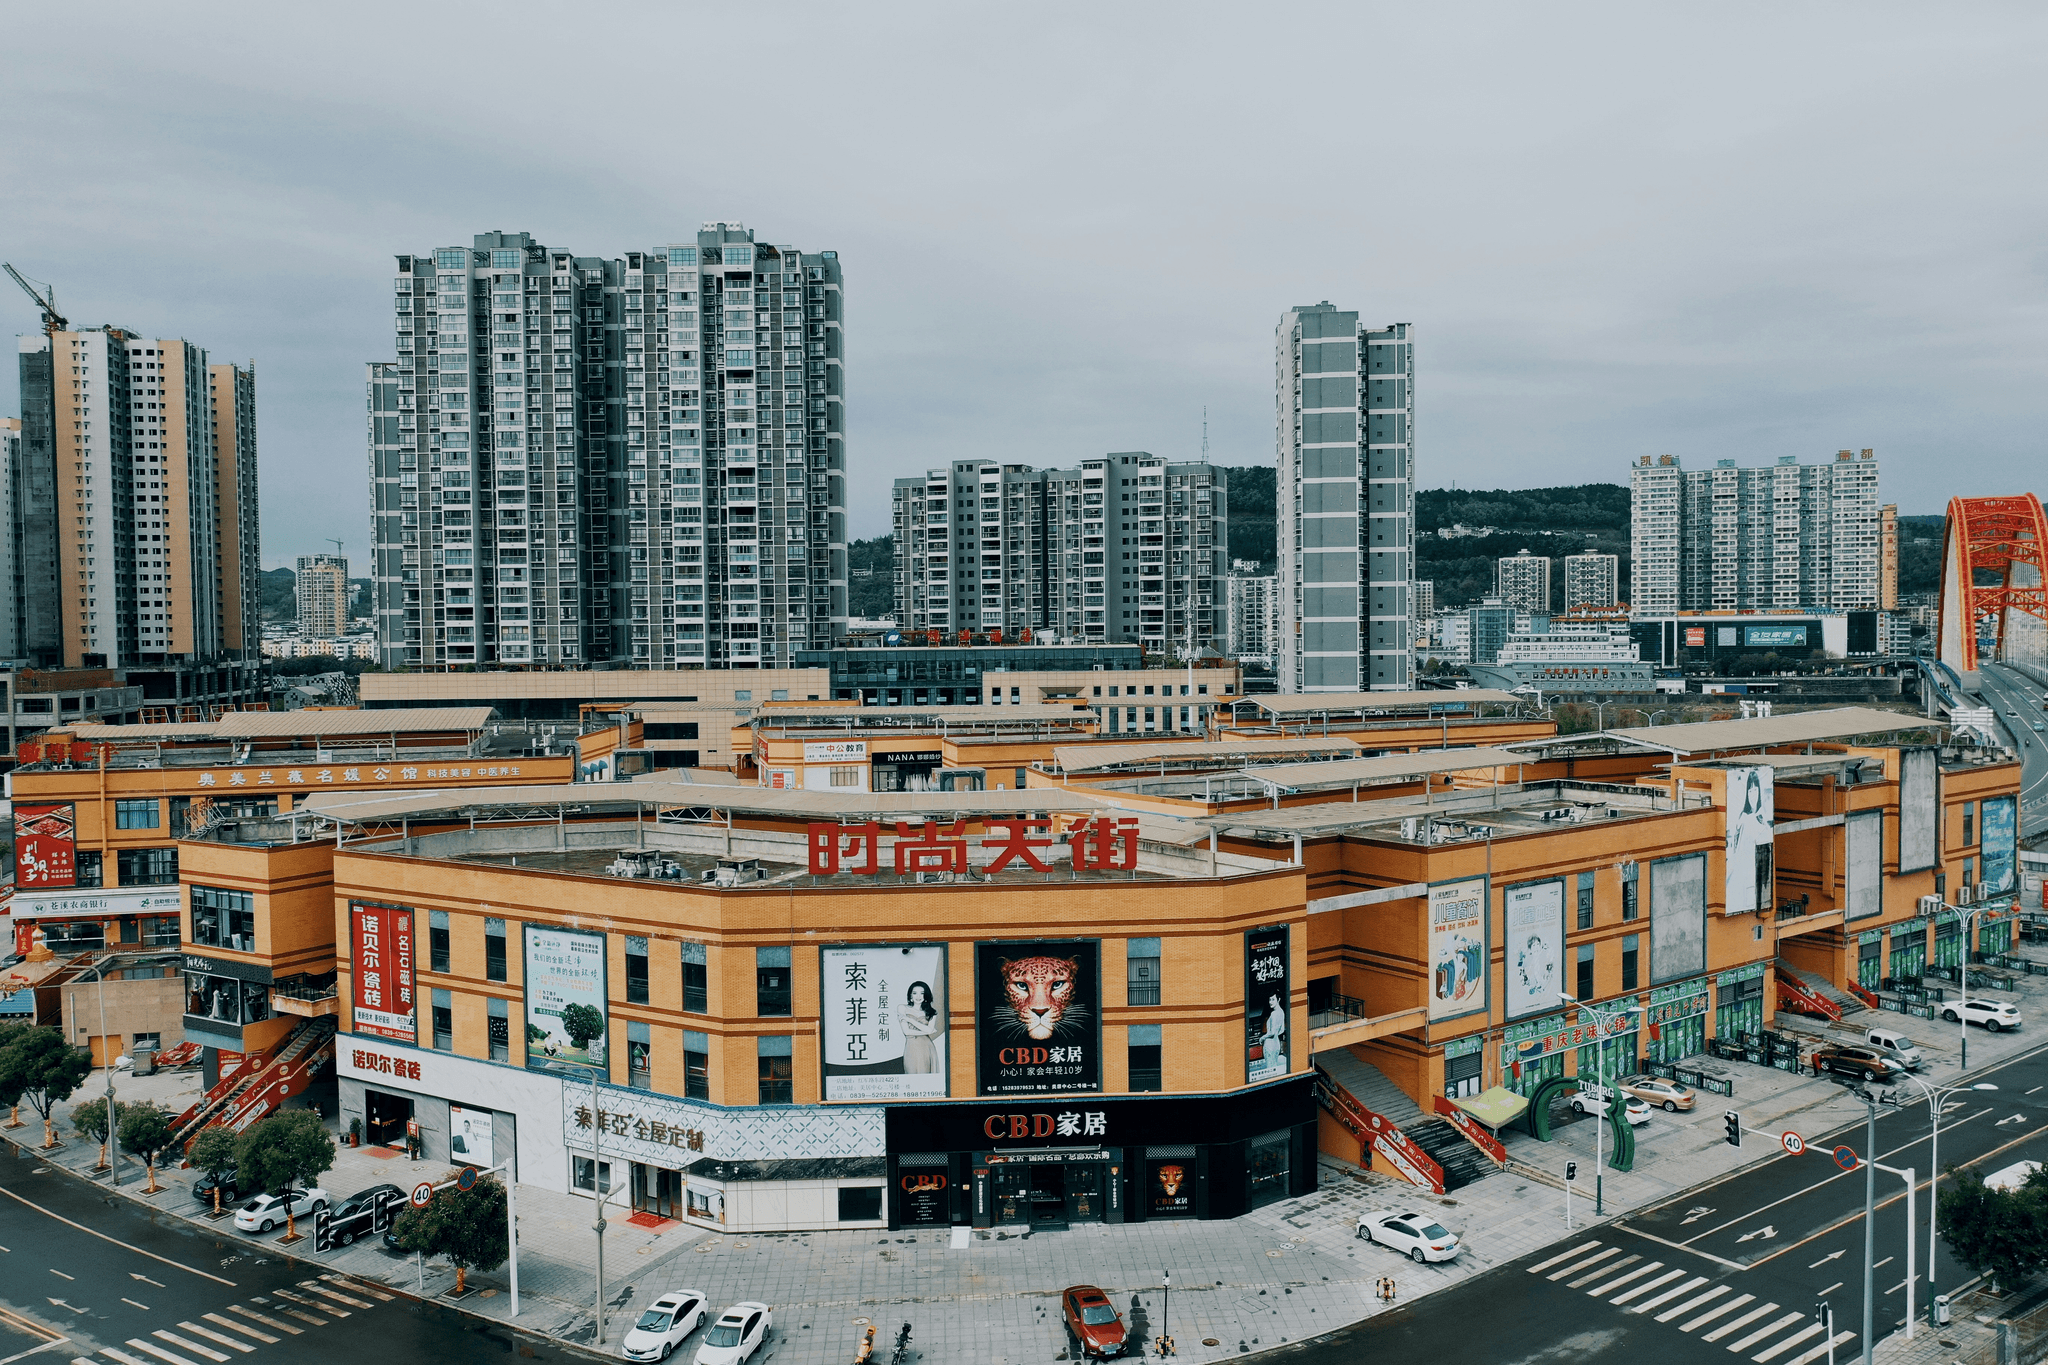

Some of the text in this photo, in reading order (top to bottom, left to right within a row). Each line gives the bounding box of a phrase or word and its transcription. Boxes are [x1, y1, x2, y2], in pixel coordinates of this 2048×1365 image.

[827, 744, 864, 753] 中公教育
[198, 766, 521, 786] 奥美兰薇名媛公馆 科技美容 中医养生
[808, 817, 1140, 875] 时尚天街
[50, 899, 108, 910] 苍溪农商银行
[1434, 898, 1479, 924] 儿童餐饮
[361, 914, 381, 1007] 诺贝尔瓷砖
[845, 962, 868, 1061] 索菲亞
[877, 979, 890, 1042] 全屋定制
[1541, 1016, 1627, 1053] 重庆老味火锅
[351, 1049, 421, 1082] 诺贝尔瓷砖
[999, 1046, 1083, 1065] CBD家居
[1578, 1080, 1614, 1098] TUBORG
[984, 1111, 1107, 1139] CBD家居
[1786, 1137, 1800, 1150] 40
[415, 1188, 429, 1201] 40
[901, 1175, 947, 1191] CBD
